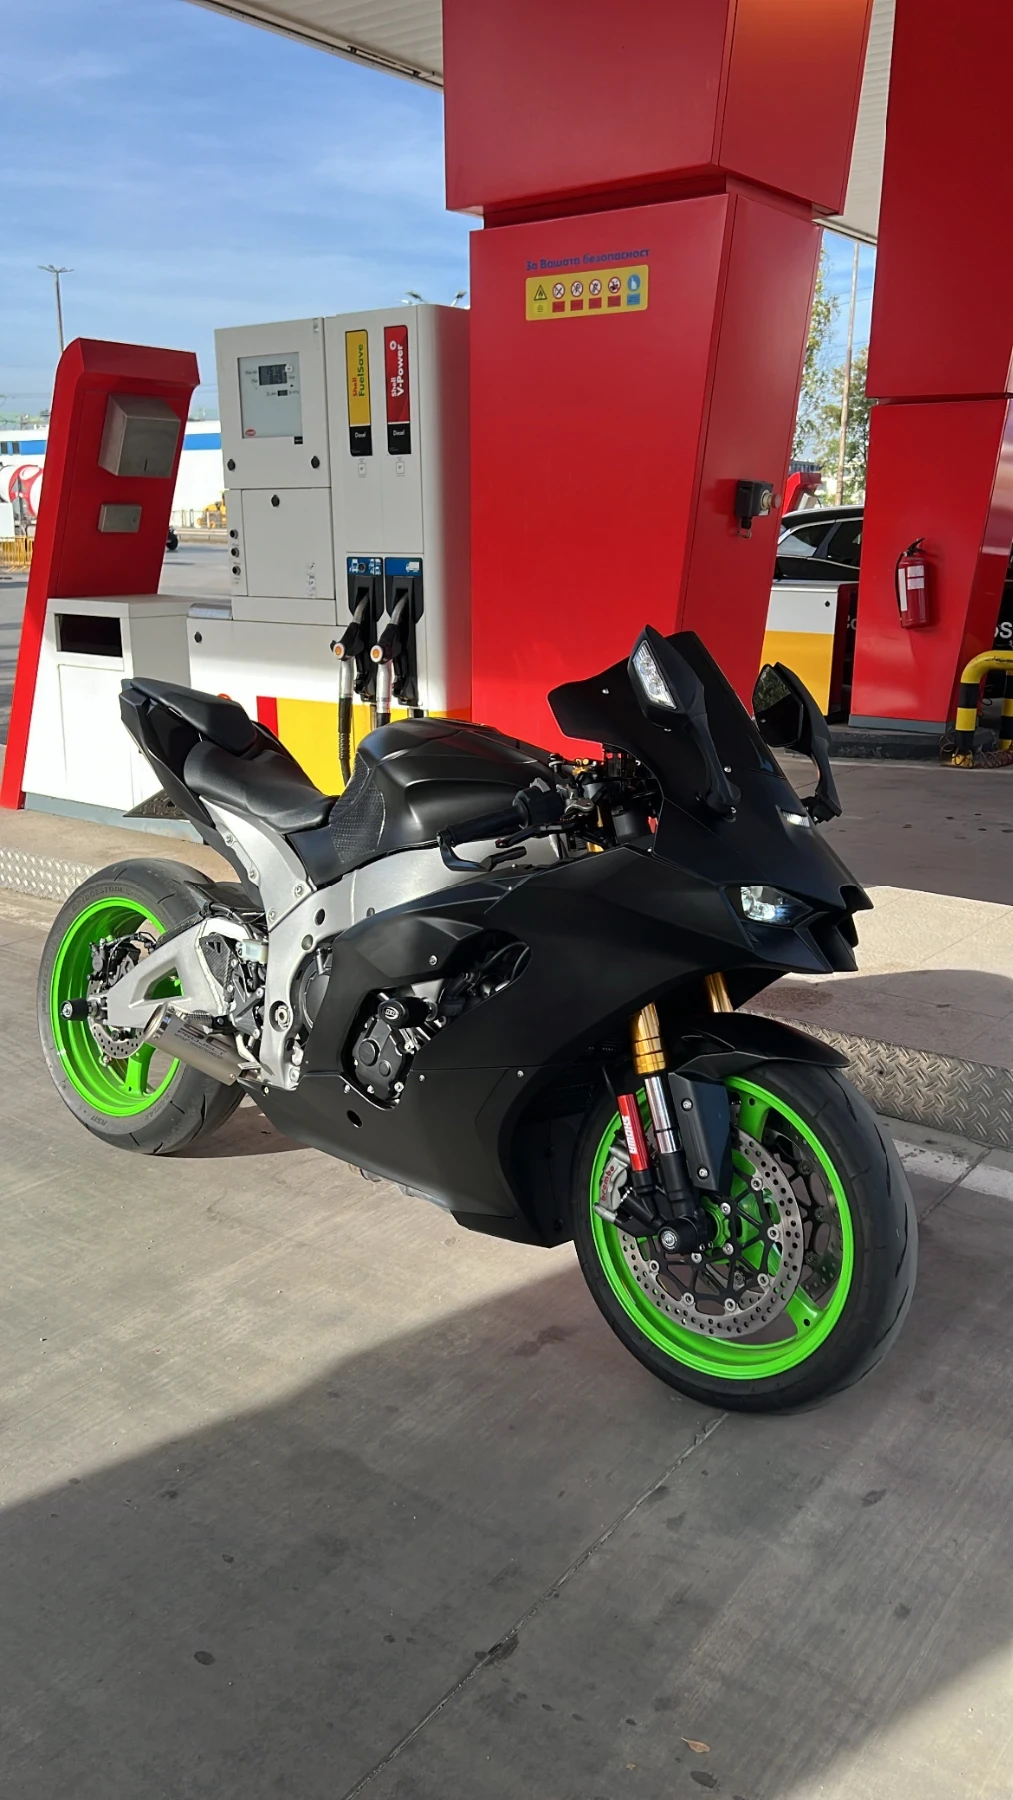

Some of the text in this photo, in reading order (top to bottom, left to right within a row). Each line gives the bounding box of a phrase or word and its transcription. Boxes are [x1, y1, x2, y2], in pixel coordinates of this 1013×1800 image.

[526, 249, 650, 271] За Вашата безопасност
[357, 344, 365, 396] FuelSave
[396, 344, 404, 396] V-Power
[180, 1023, 232, 1053] SC
[601, 1165, 615, 1202] brembo
